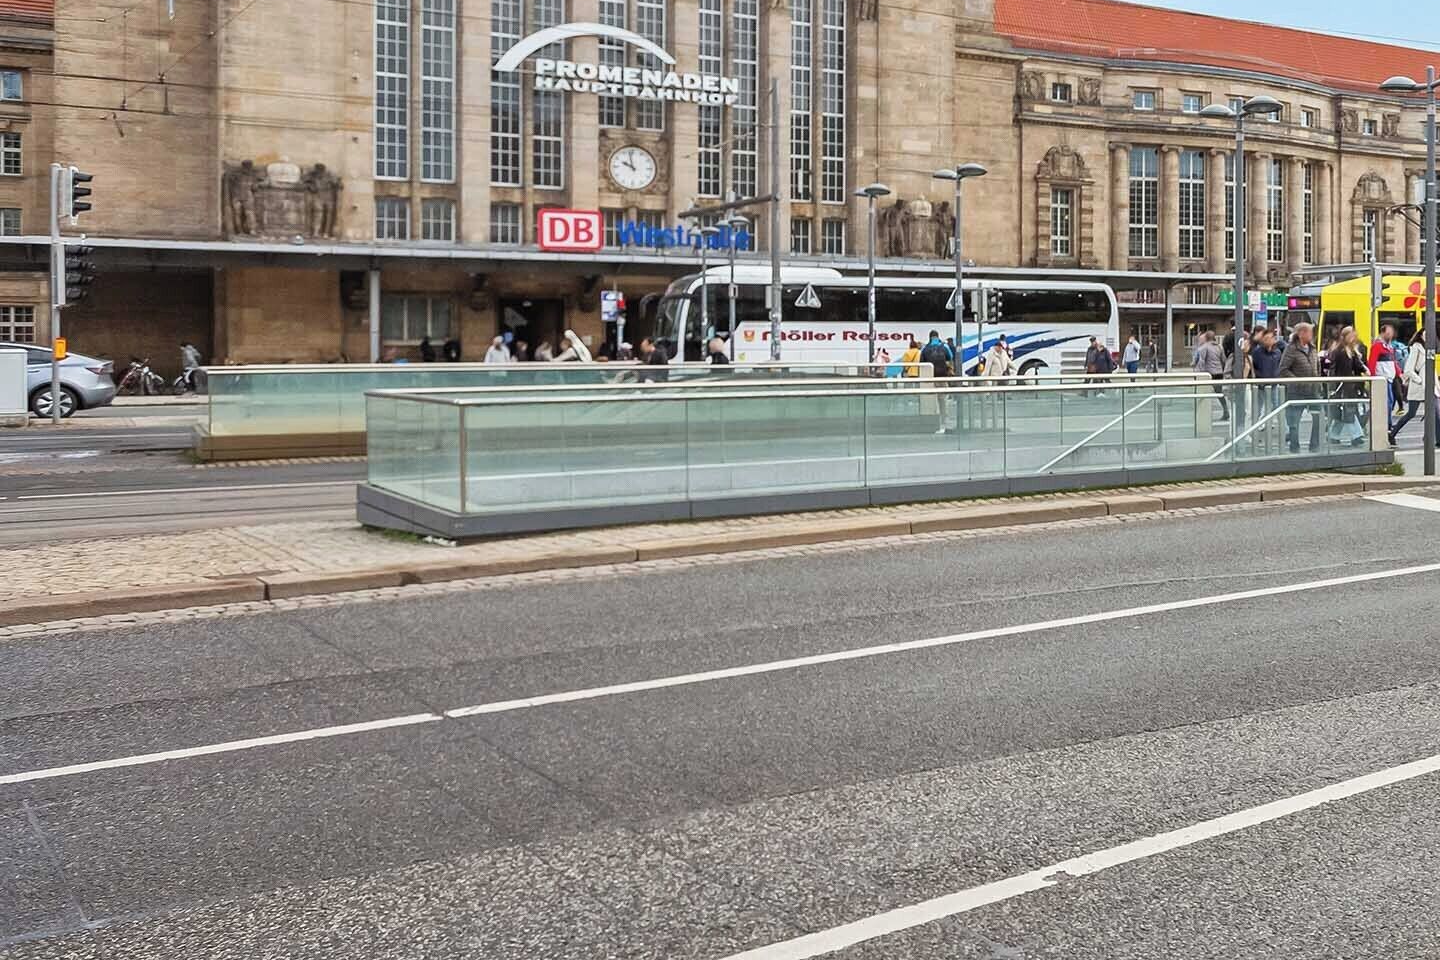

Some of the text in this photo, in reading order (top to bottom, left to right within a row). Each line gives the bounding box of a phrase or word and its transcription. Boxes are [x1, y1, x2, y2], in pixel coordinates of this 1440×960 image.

[535, 58, 739, 94] PROMENADEN
[535, 76, 739, 106] HAUPTBAHNHOF
[549, 217, 594, 243] DB
[843, 330, 914, 341] Reisen
